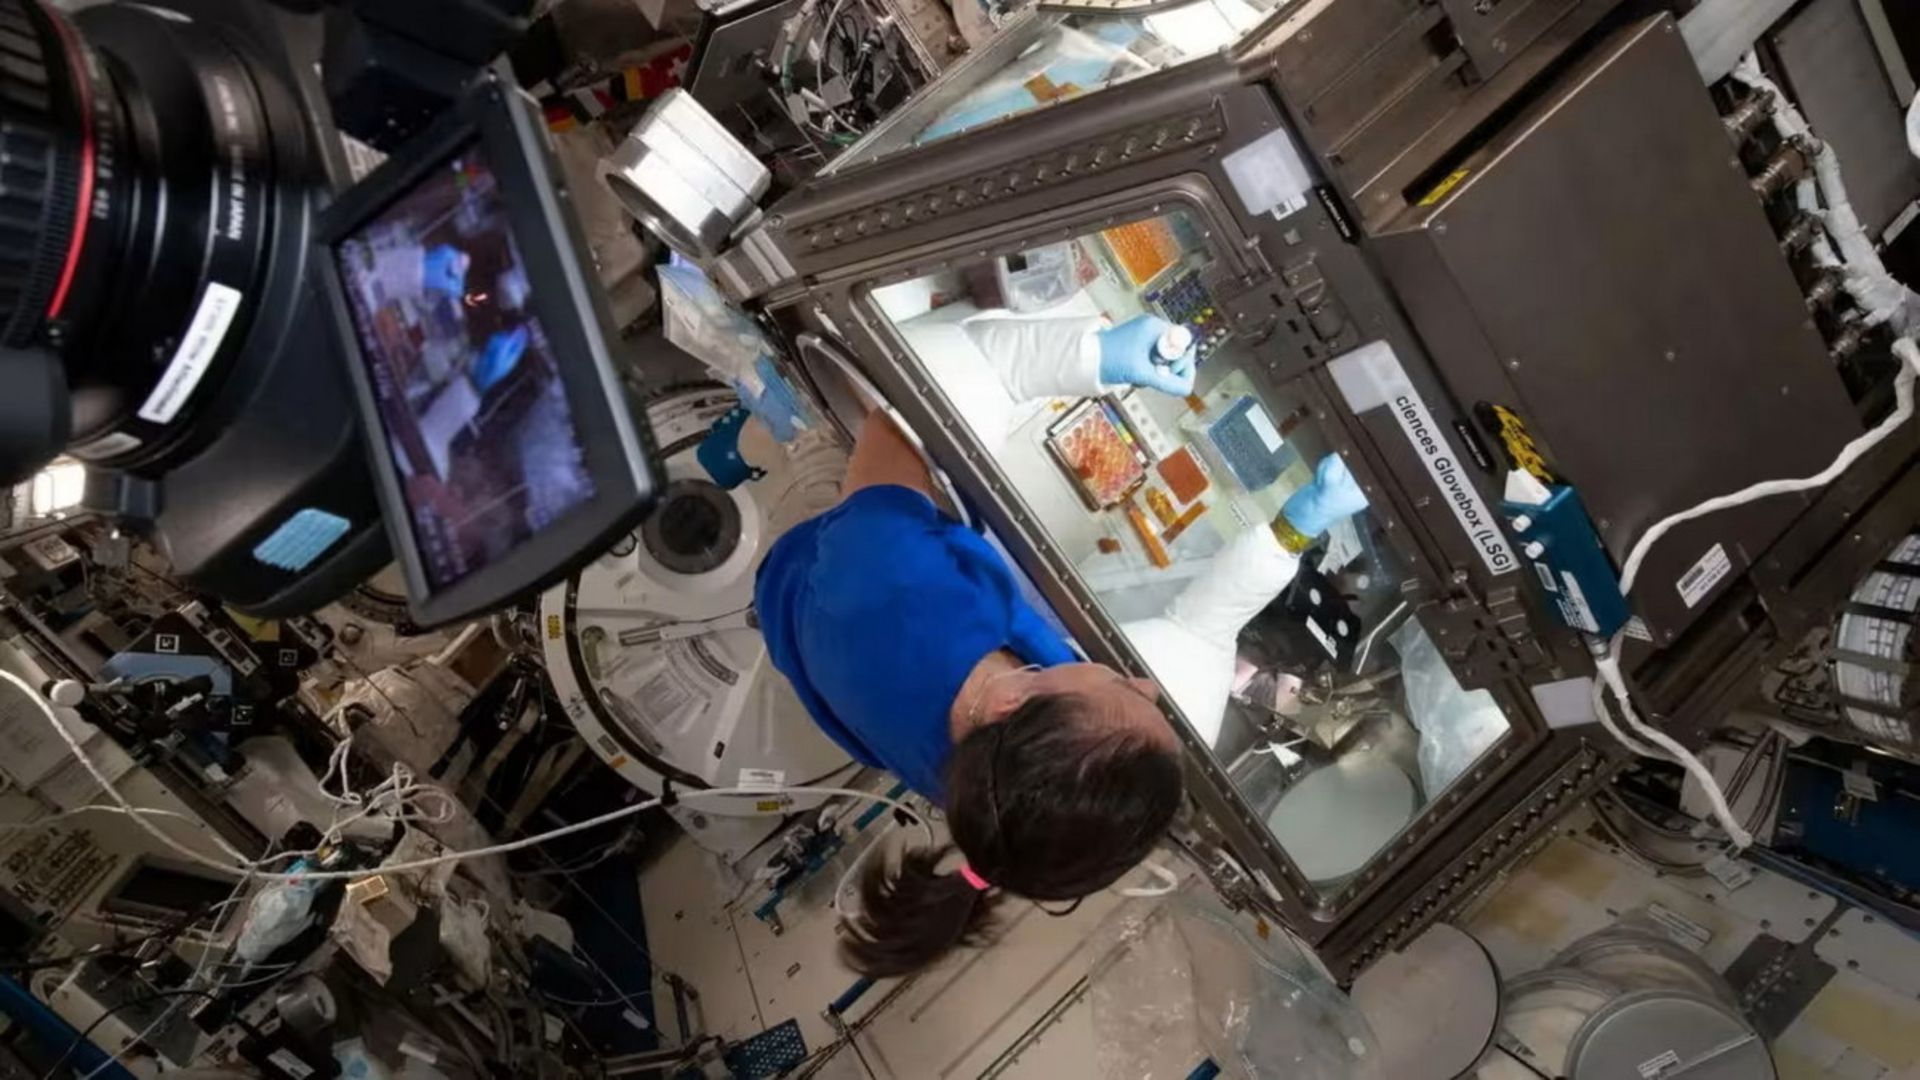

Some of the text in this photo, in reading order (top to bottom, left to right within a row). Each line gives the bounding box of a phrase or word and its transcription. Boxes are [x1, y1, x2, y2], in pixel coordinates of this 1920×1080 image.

[1396, 395, 1513, 572] ciences Glovebox (LSG)
